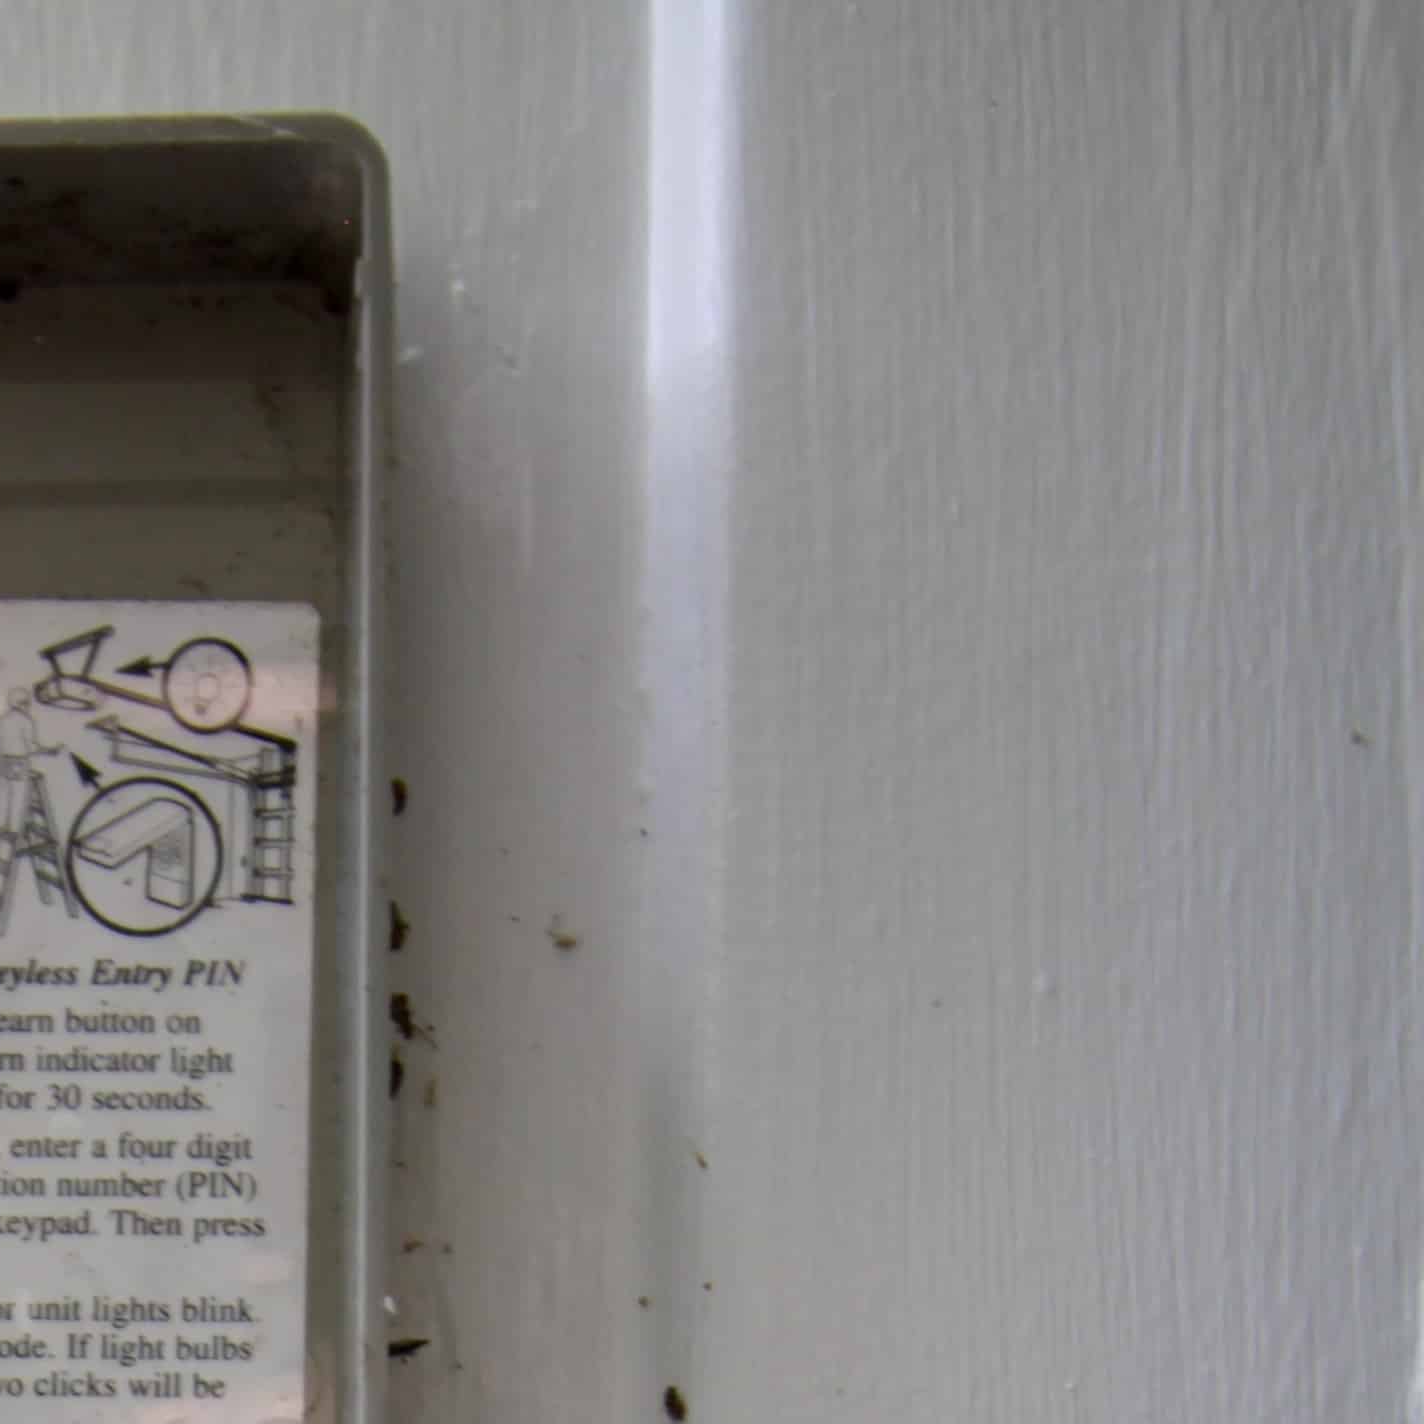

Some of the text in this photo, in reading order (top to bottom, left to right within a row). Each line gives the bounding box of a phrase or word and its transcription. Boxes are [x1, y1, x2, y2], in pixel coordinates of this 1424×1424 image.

[92, 958, 172, 992] Entry
[184, 959, 246, 987] PIN
[65, 1007, 155, 1035] button
[166, 1014, 200, 1035] on
[35, 1046, 160, 1073] indicator
[171, 1046, 233, 1080] light
[47, 1084, 81, 1111] 30
[92, 1084, 210, 1112] seconds.
[10, 1134, 80, 1159] enter
[117, 1132, 175, 1160] four
[187, 1133, 251, 1166] digit
[57, 1170, 164, 1198] number
[176, 1171, 256, 1204] (PIN)
[111, 1209, 182, 1237] Then
[193, 1217, 265, 1244] press
[28, 1295, 80, 1323] unit
[92, 1296, 170, 1329] lights
[67, 1333, 91, 1361] If
[100, 1334, 163, 1367] light
[176, 1334, 251, 1362] bulbs
[34, 1371, 116, 1399] clicks
[129, 1372, 183, 1400] will
[193, 1372, 225, 1400] be
